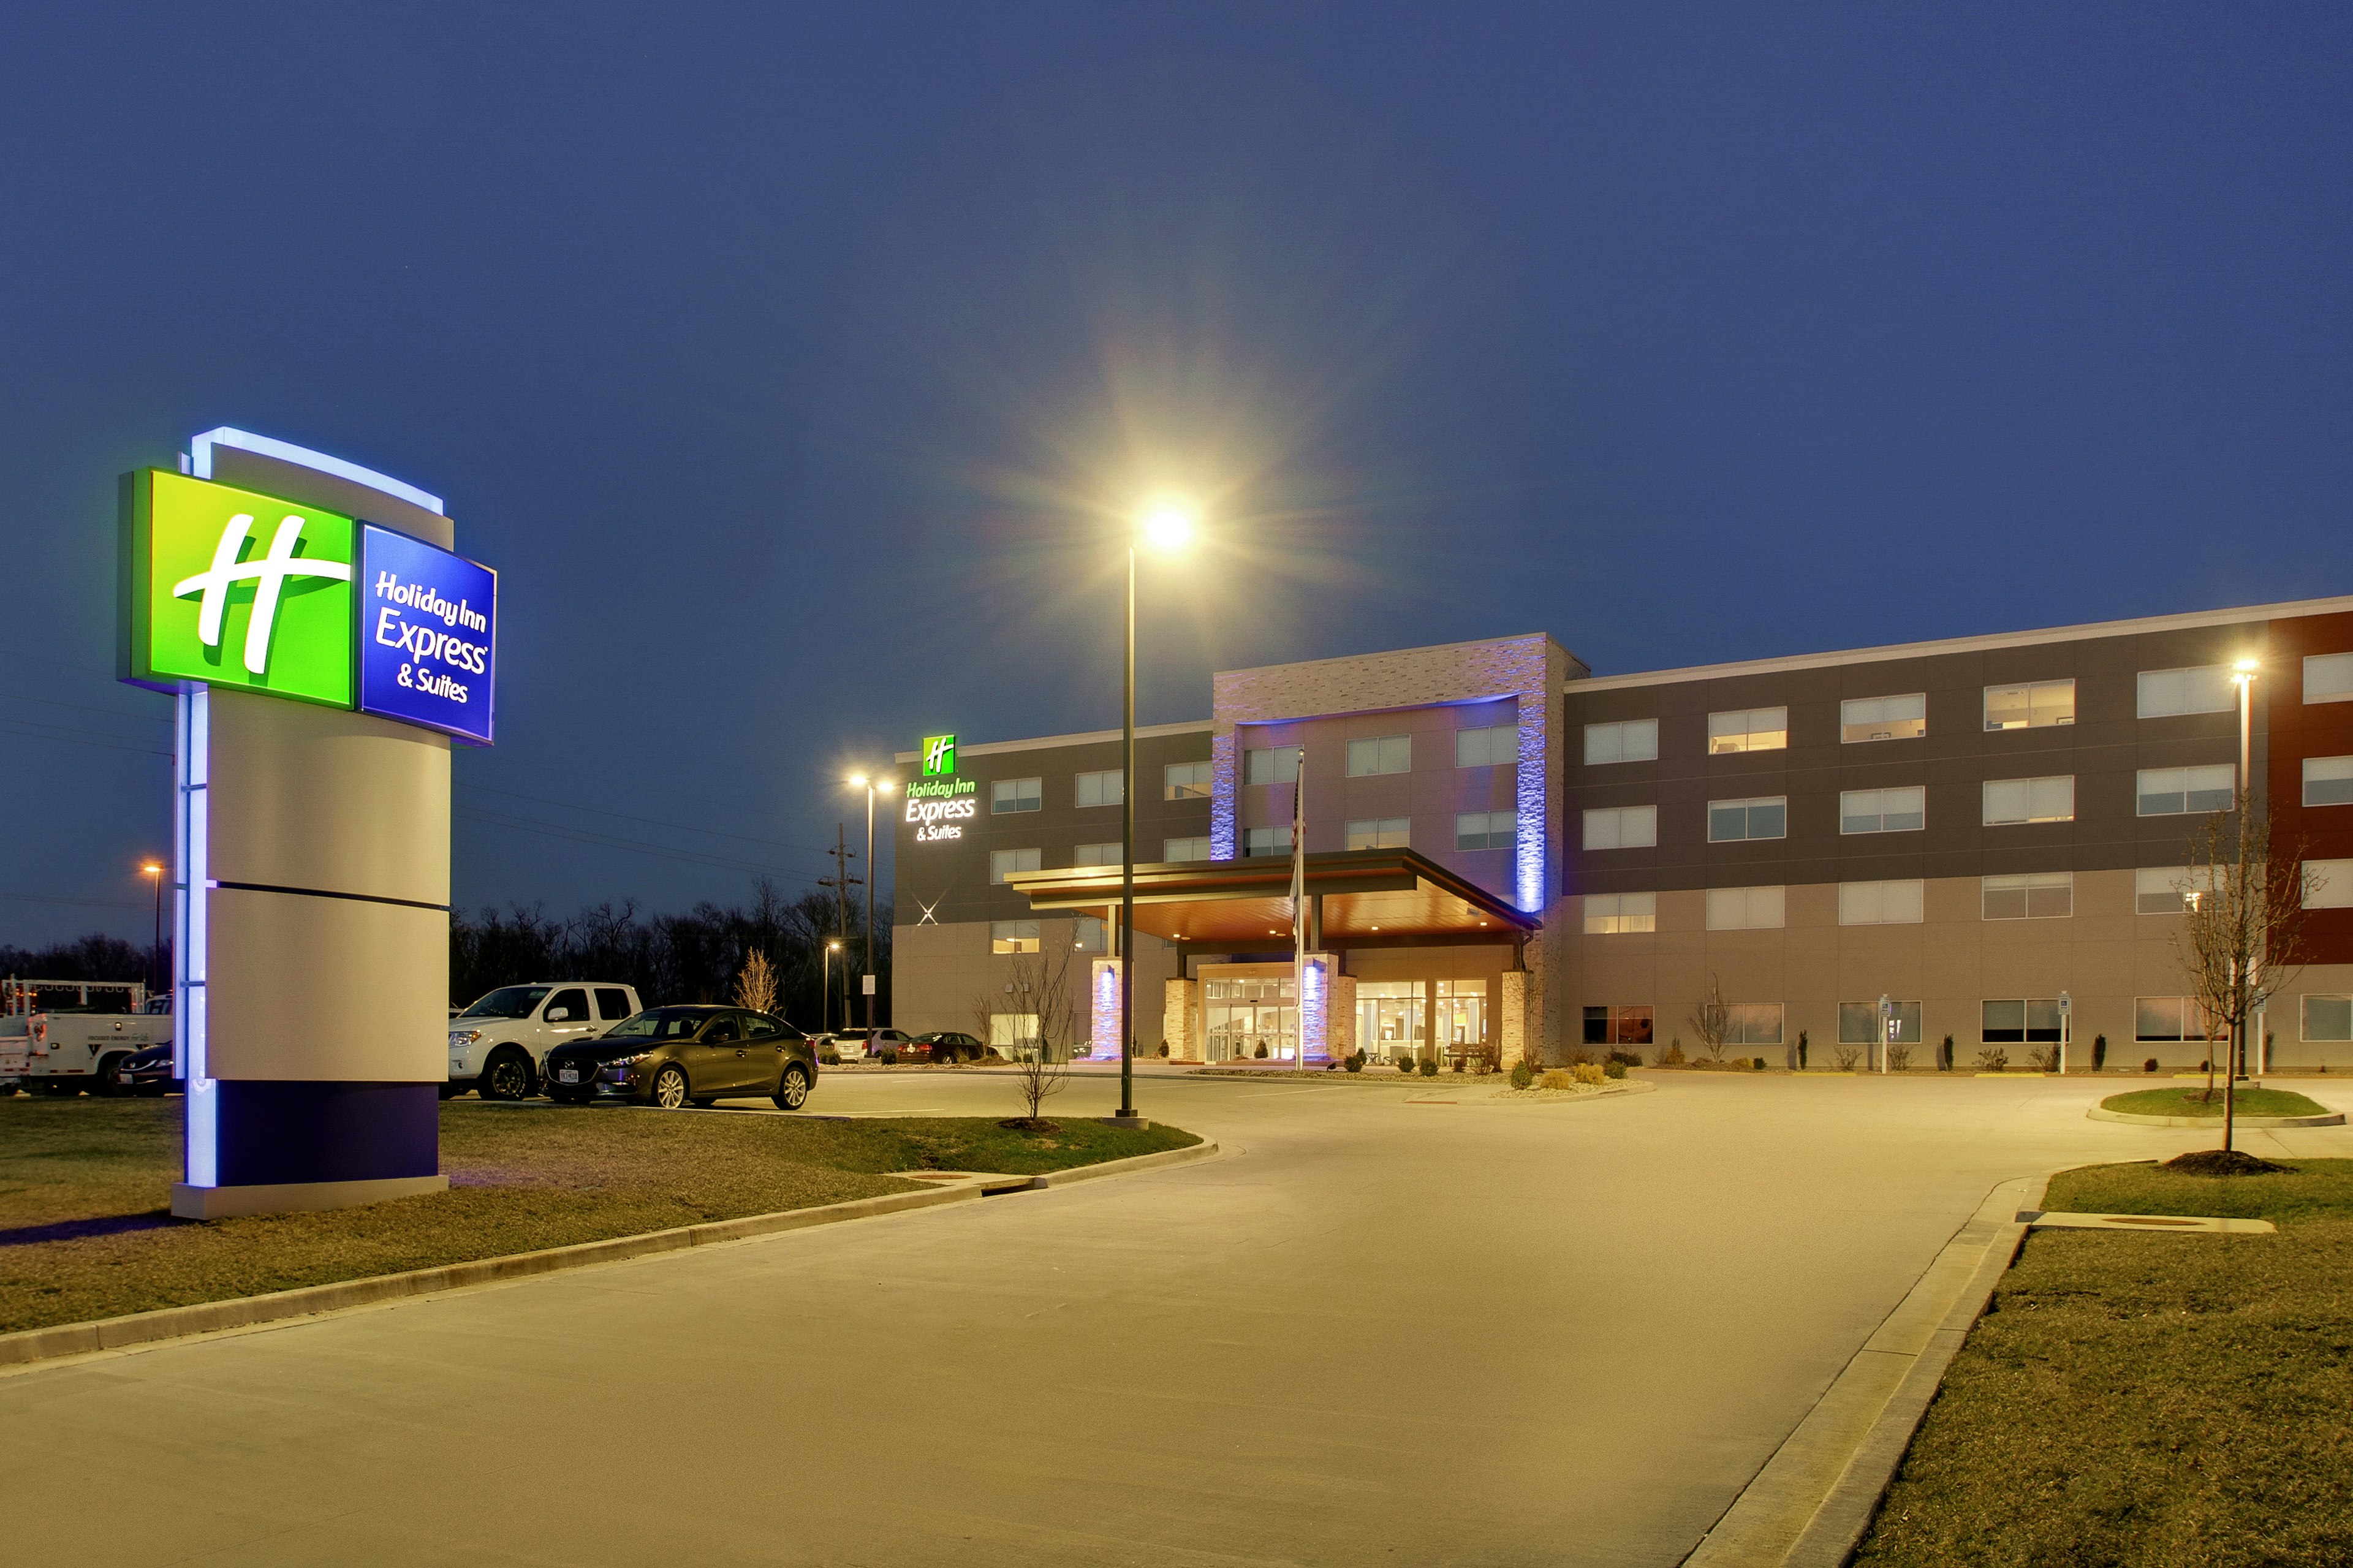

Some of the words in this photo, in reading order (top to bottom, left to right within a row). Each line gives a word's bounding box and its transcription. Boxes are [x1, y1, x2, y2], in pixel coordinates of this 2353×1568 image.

[375, 570, 458, 626] Holiday
[459, 599, 486, 633] Inn
[376, 607, 486, 674] Express
[397, 663, 412, 687] &
[415, 668, 468, 703] Suites
[906, 780, 954, 798] Holiday
[955, 778, 975, 794] Inn
[906, 798, 976, 826] Express
[917, 827, 926, 841] &
[926, 824, 962, 841] Suites
